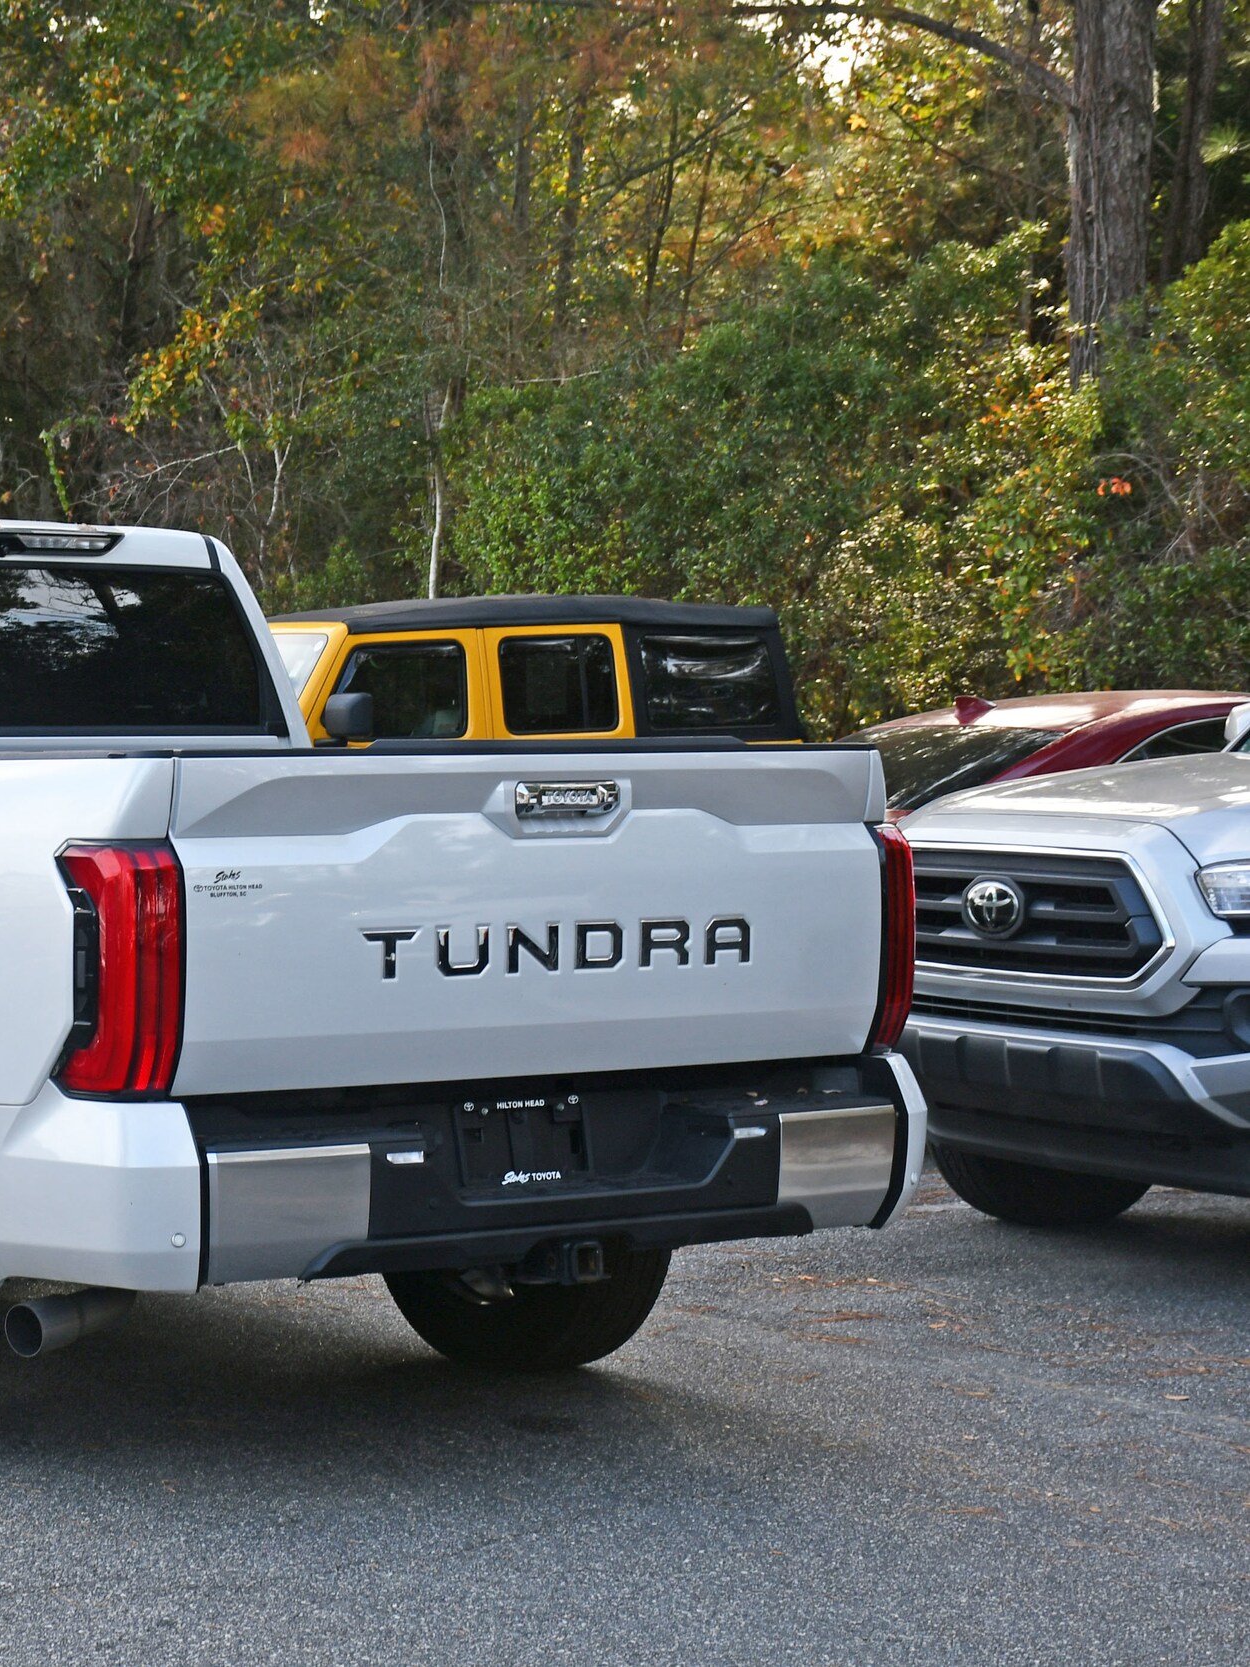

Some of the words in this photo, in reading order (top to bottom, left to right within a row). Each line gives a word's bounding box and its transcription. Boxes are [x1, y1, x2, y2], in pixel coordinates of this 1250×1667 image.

[545, 790, 594, 803] TOYOTA
[360, 915, 751, 980] TUNDRA
[496, 1101, 523, 1109] HILTON
[525, 1099, 545, 1107] HEAD
[532, 1171, 561, 1181] TOYOTA
